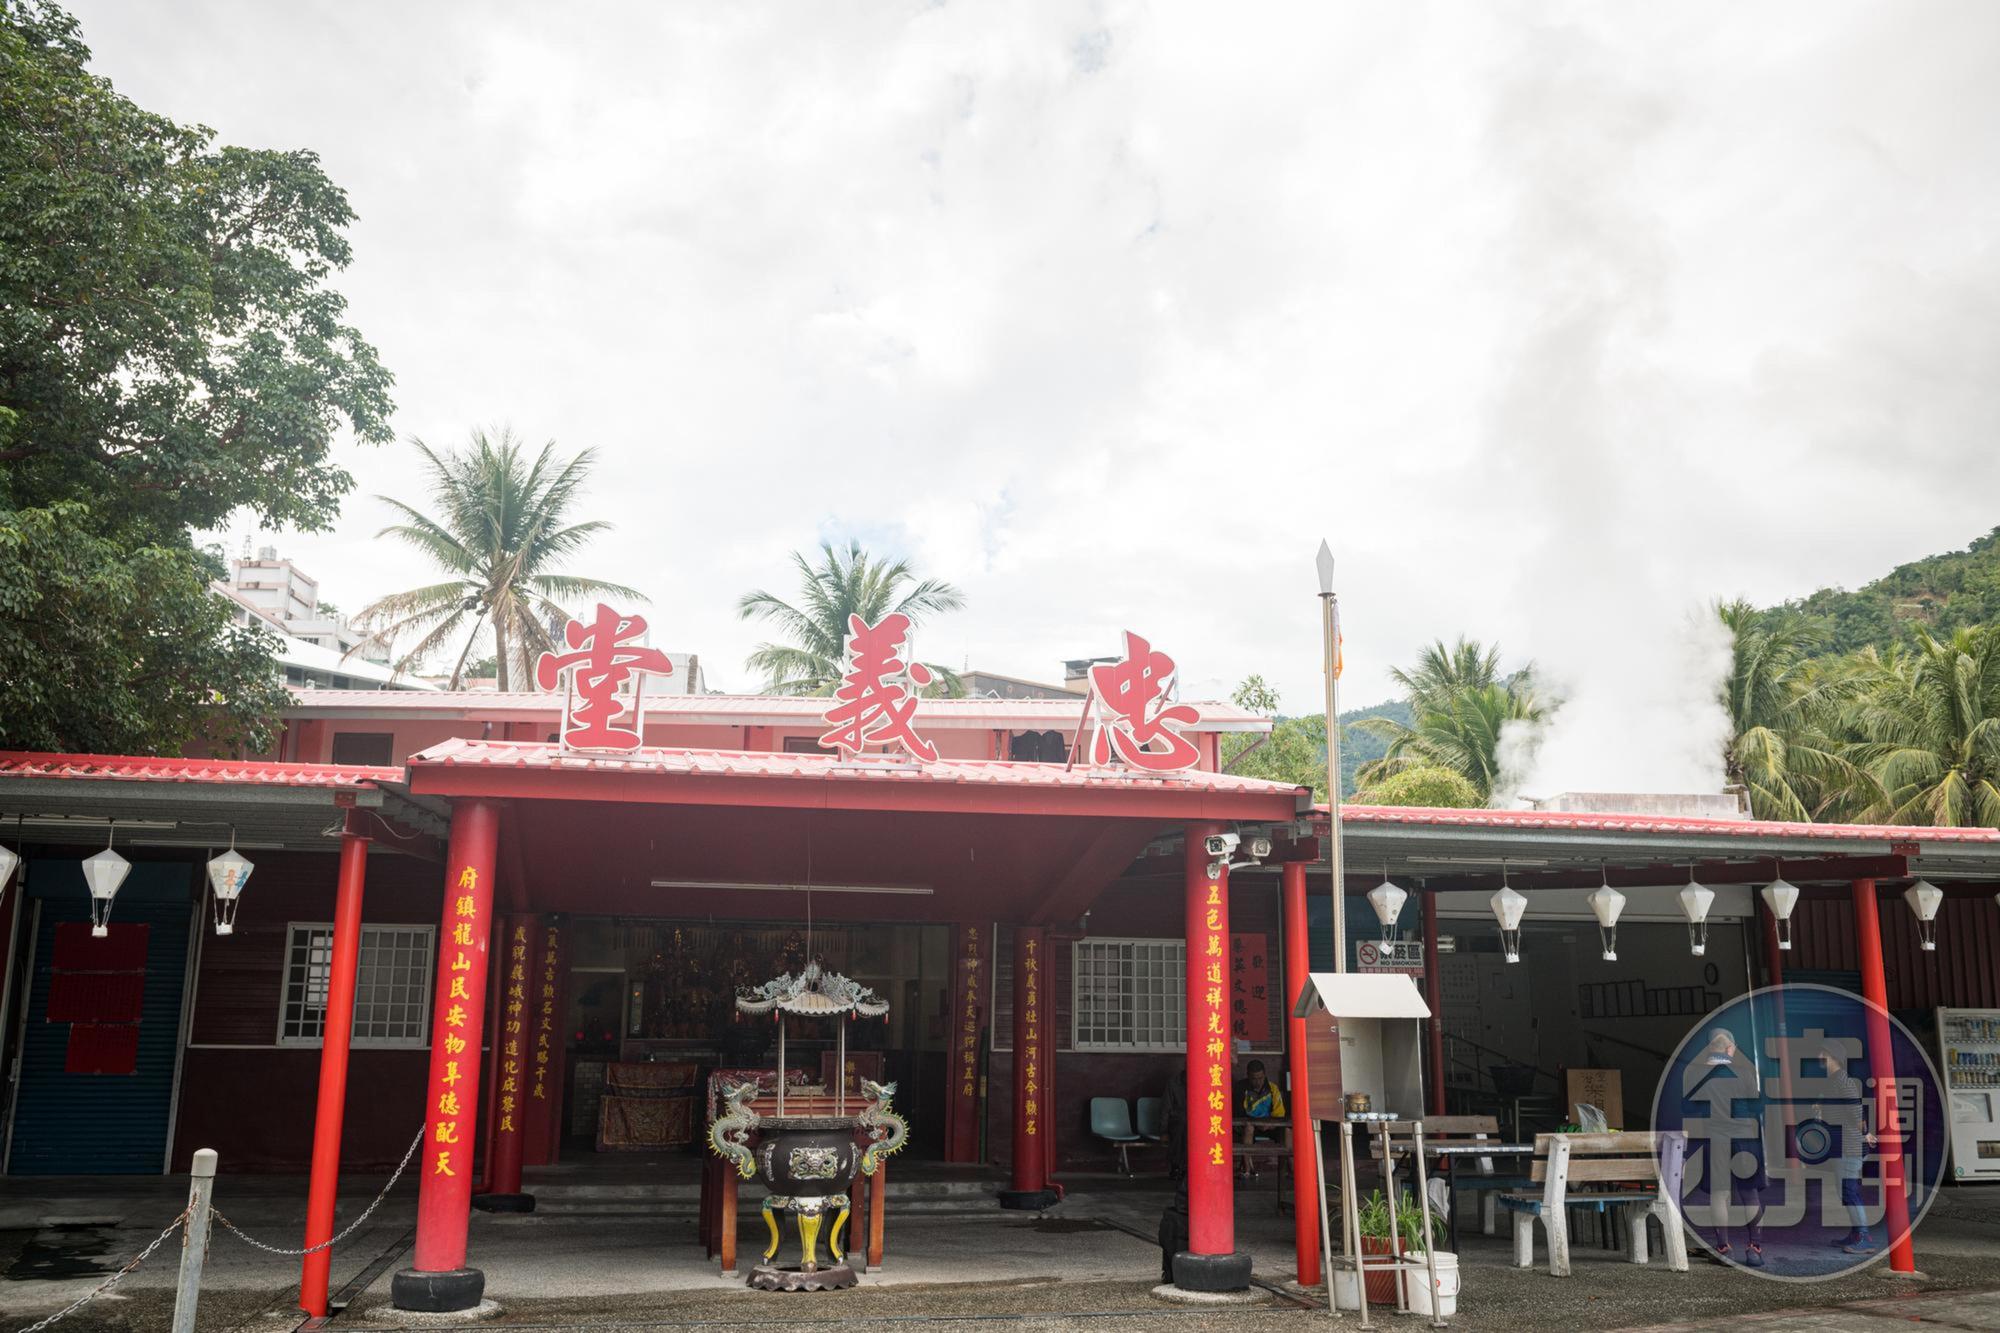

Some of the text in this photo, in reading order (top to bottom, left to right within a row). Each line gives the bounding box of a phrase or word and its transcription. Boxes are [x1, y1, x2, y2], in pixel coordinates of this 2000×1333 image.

[535, 602, 1202, 772] 忠義堂
[434, 865, 479, 1177] 府鎮龍山民安物阜德配天
